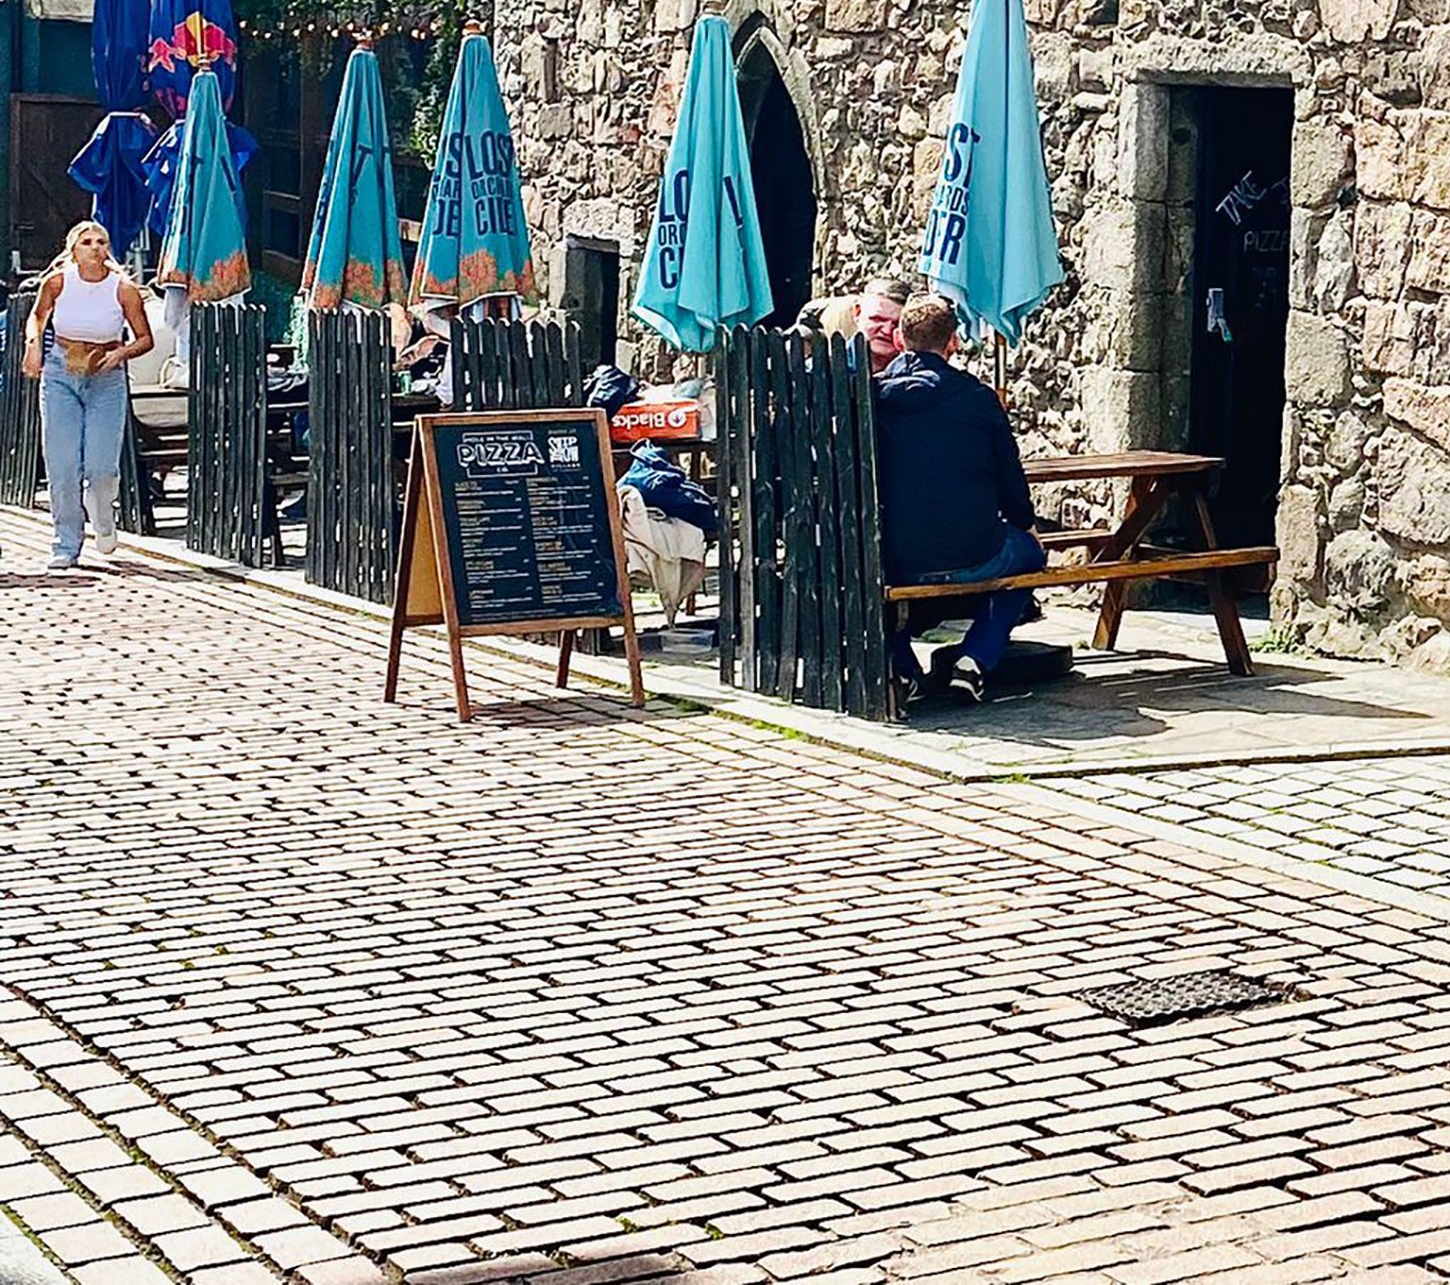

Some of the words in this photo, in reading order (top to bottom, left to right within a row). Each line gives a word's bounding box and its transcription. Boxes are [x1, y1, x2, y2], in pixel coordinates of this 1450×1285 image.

[1215, 170, 1268, 225] TAKE
[611, 412, 666, 431] Blacks
[456, 442, 545, 467] PIZZA
